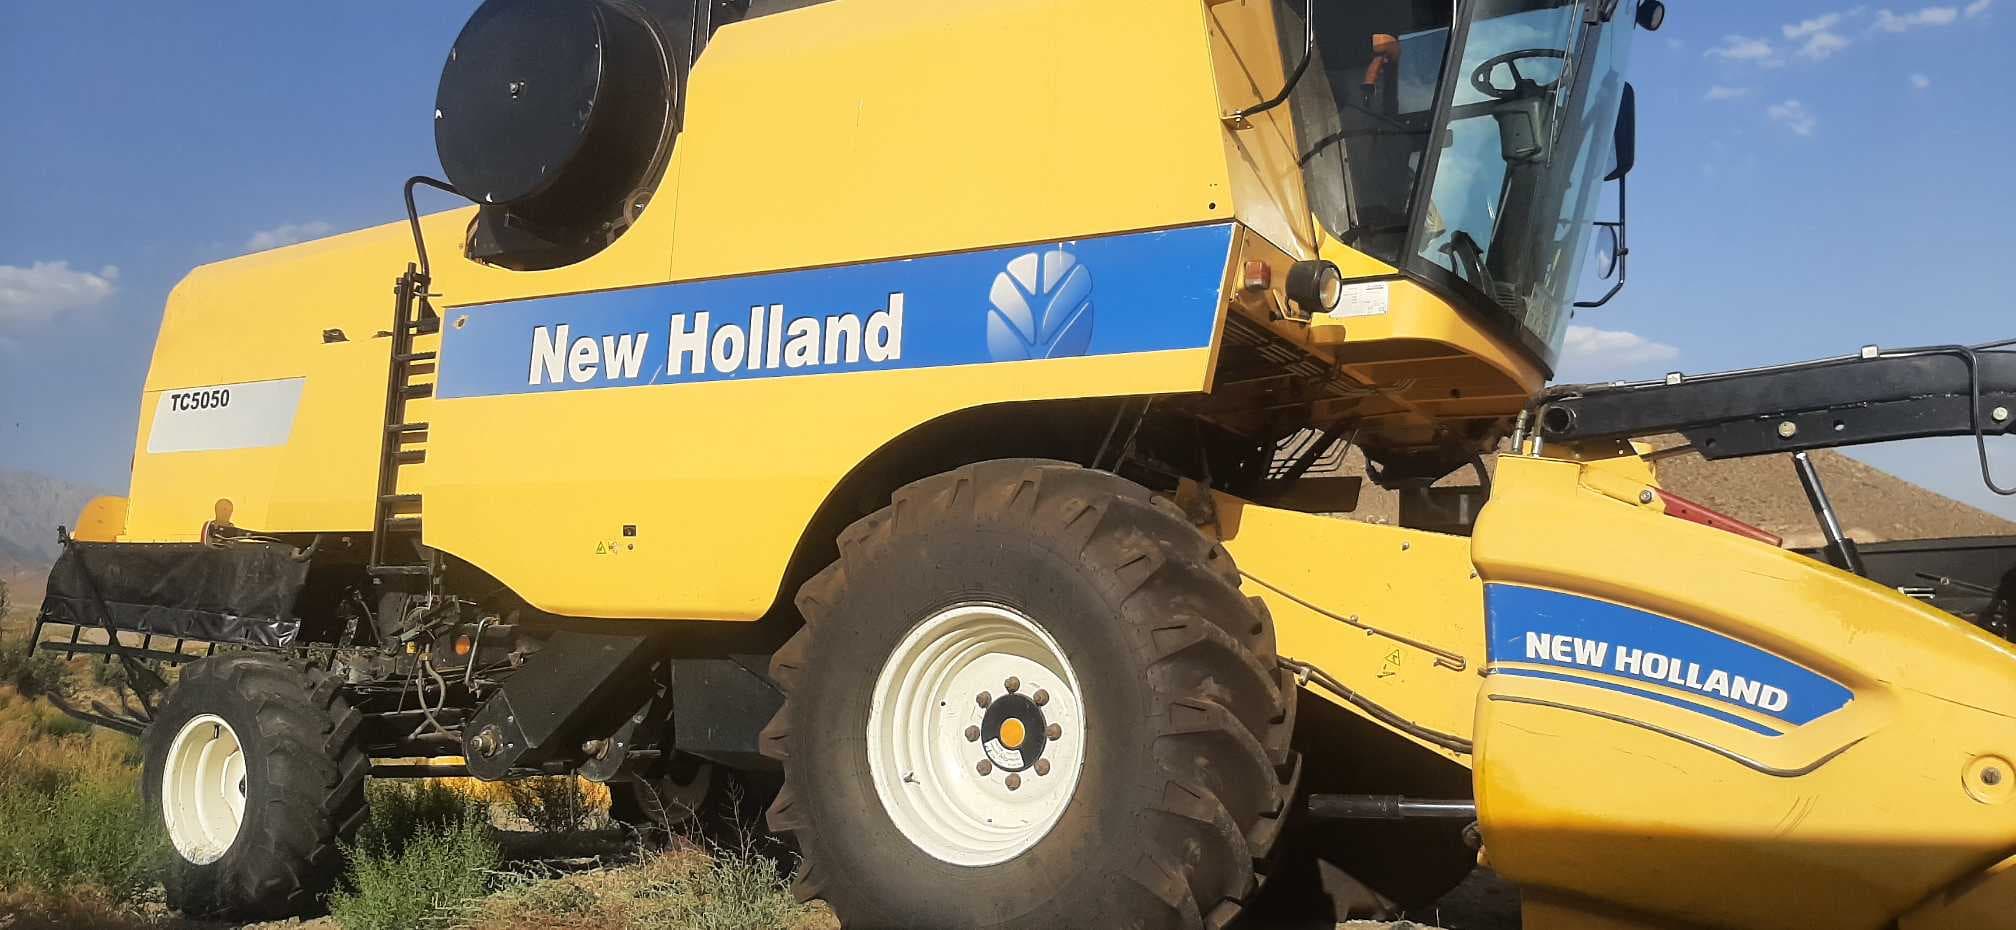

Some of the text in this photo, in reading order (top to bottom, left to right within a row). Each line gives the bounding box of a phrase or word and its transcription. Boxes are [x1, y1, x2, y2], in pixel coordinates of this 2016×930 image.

[527, 292, 904, 385] New Holland
[171, 389, 230, 411] TC5050
[1525, 631, 1789, 713] NEW HOLLAND
